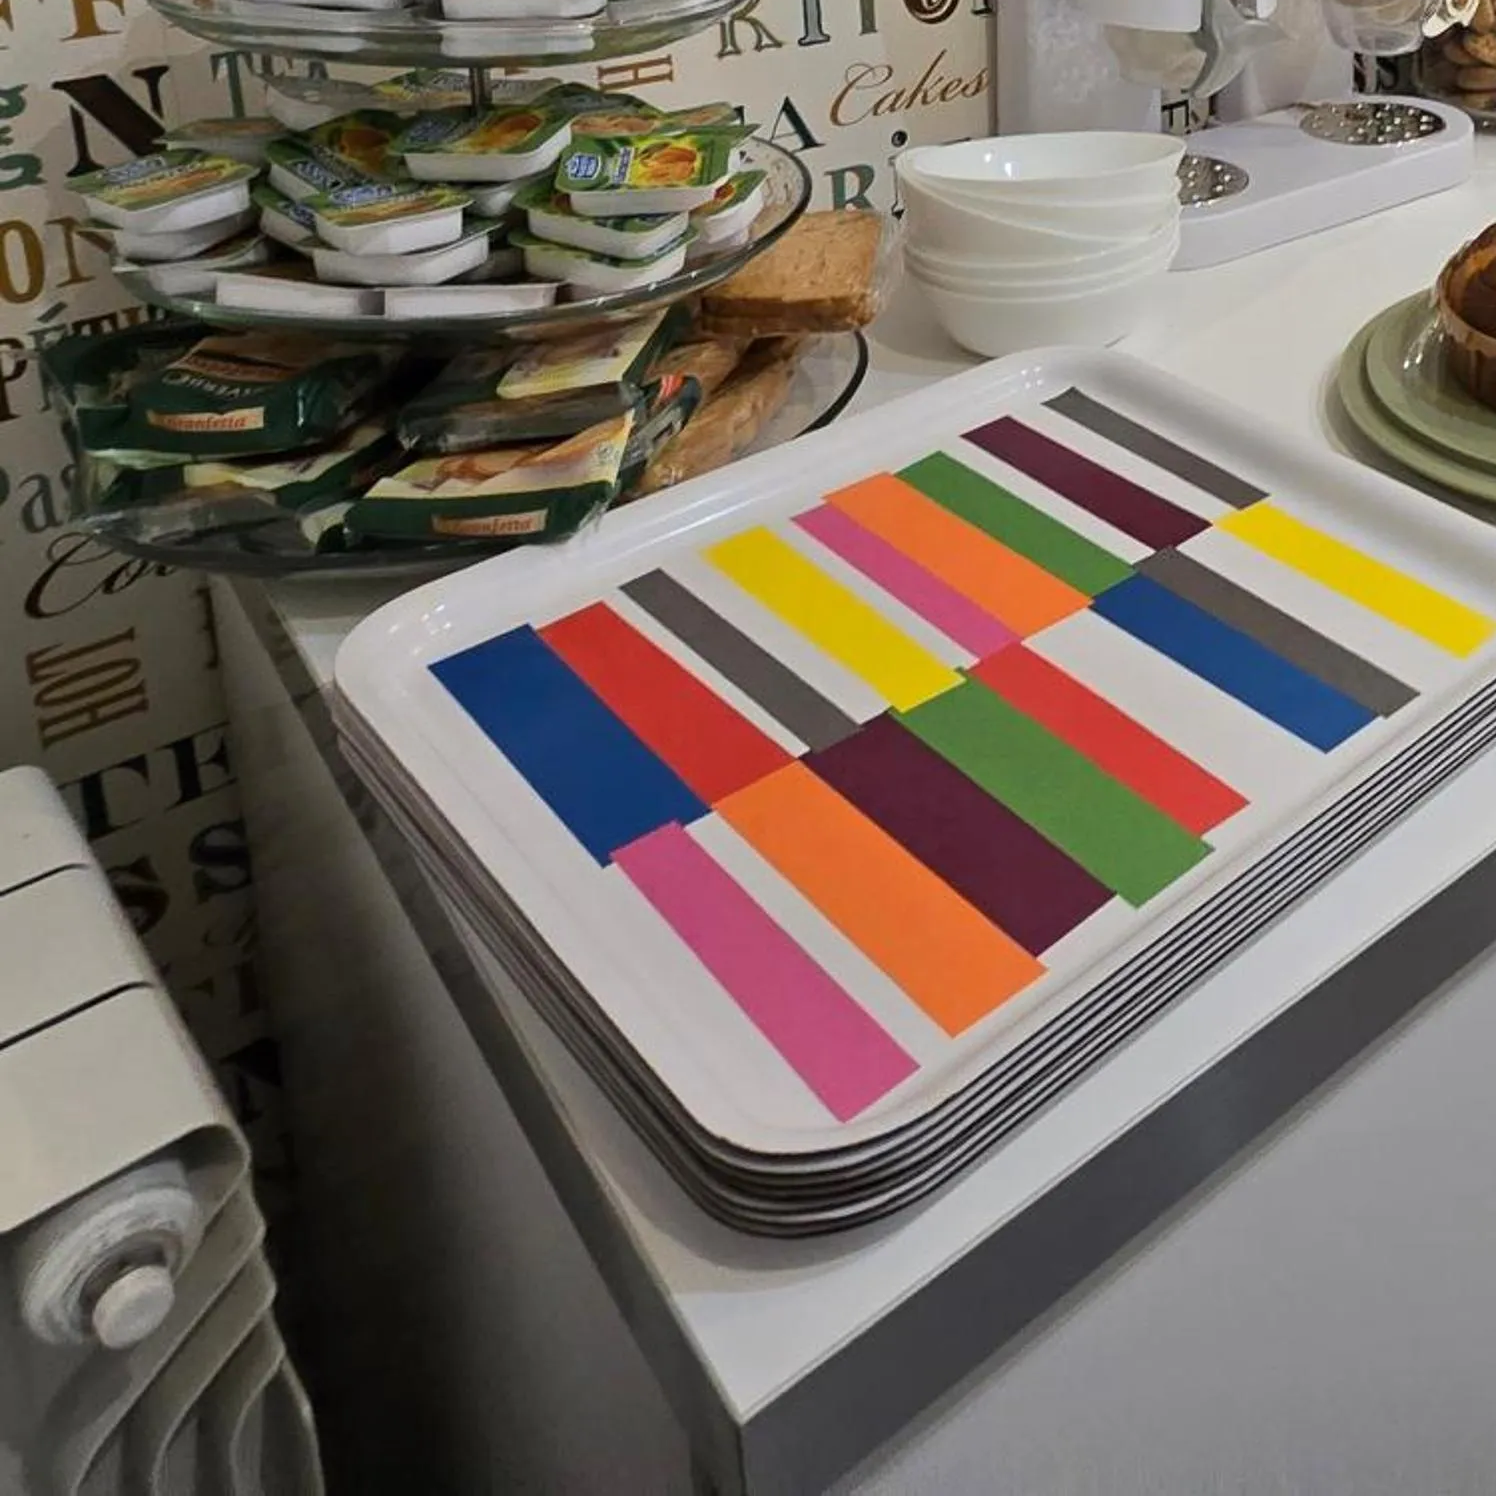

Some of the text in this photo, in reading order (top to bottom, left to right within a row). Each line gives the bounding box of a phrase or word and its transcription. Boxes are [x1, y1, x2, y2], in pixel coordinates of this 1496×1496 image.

[829, 49, 989, 127] Cakes
[26, 625, 150, 749] HOT
[57, 719, 239, 842] TE
